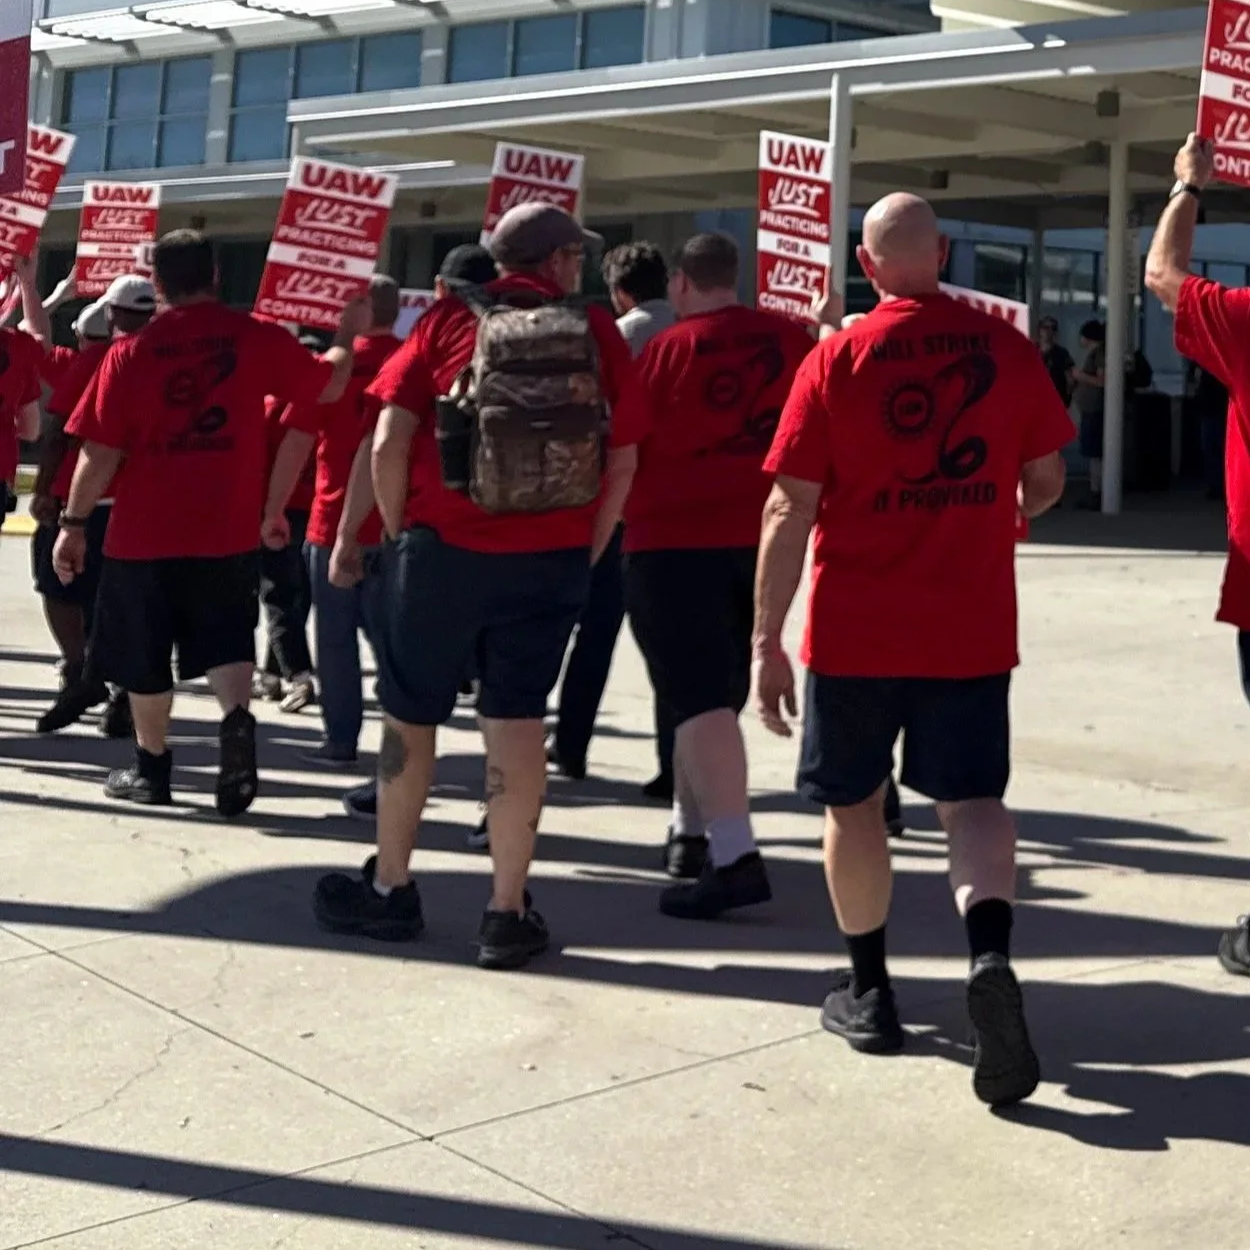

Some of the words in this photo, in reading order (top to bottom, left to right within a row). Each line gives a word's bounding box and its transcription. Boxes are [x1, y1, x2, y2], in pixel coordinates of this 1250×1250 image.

[504, 148, 575, 182] UAW
[767, 137, 826, 174] UAW
[92, 185, 153, 203] UAW
[303, 162, 388, 199] UAW
[768, 176, 825, 206] JUST
[294, 199, 378, 230] JUST
[759, 209, 829, 238] PRACTICING
[776, 237, 800, 253] FOR
[275, 270, 359, 301] JUST
[766, 259, 822, 292] JUST
